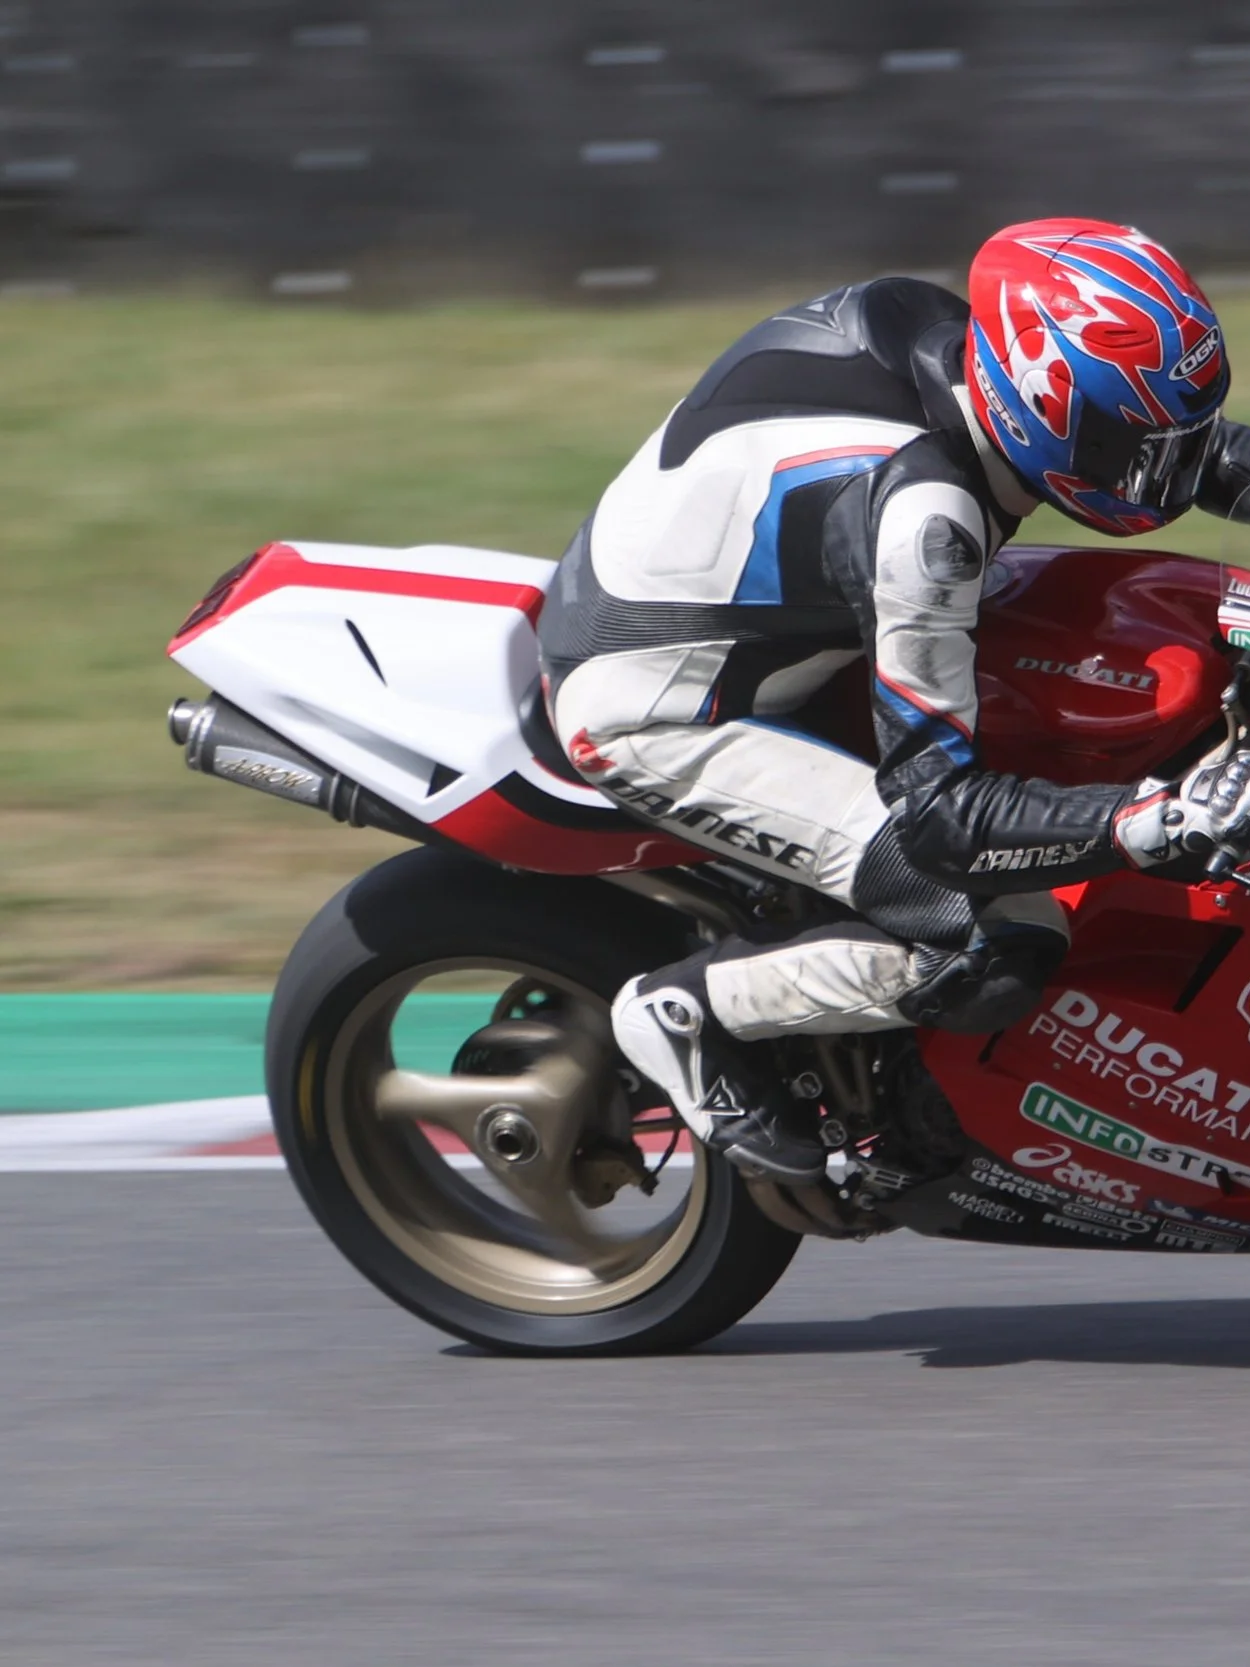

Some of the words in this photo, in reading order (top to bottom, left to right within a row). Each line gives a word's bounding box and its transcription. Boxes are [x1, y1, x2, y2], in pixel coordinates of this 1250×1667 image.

[1179, 332, 1218, 375] OGK
[978, 367, 1018, 433] OGK
[1014, 657, 1153, 689] DUCATI
[599, 777, 818, 870] DAINESE
[990, 1163, 1071, 1199] brembo
